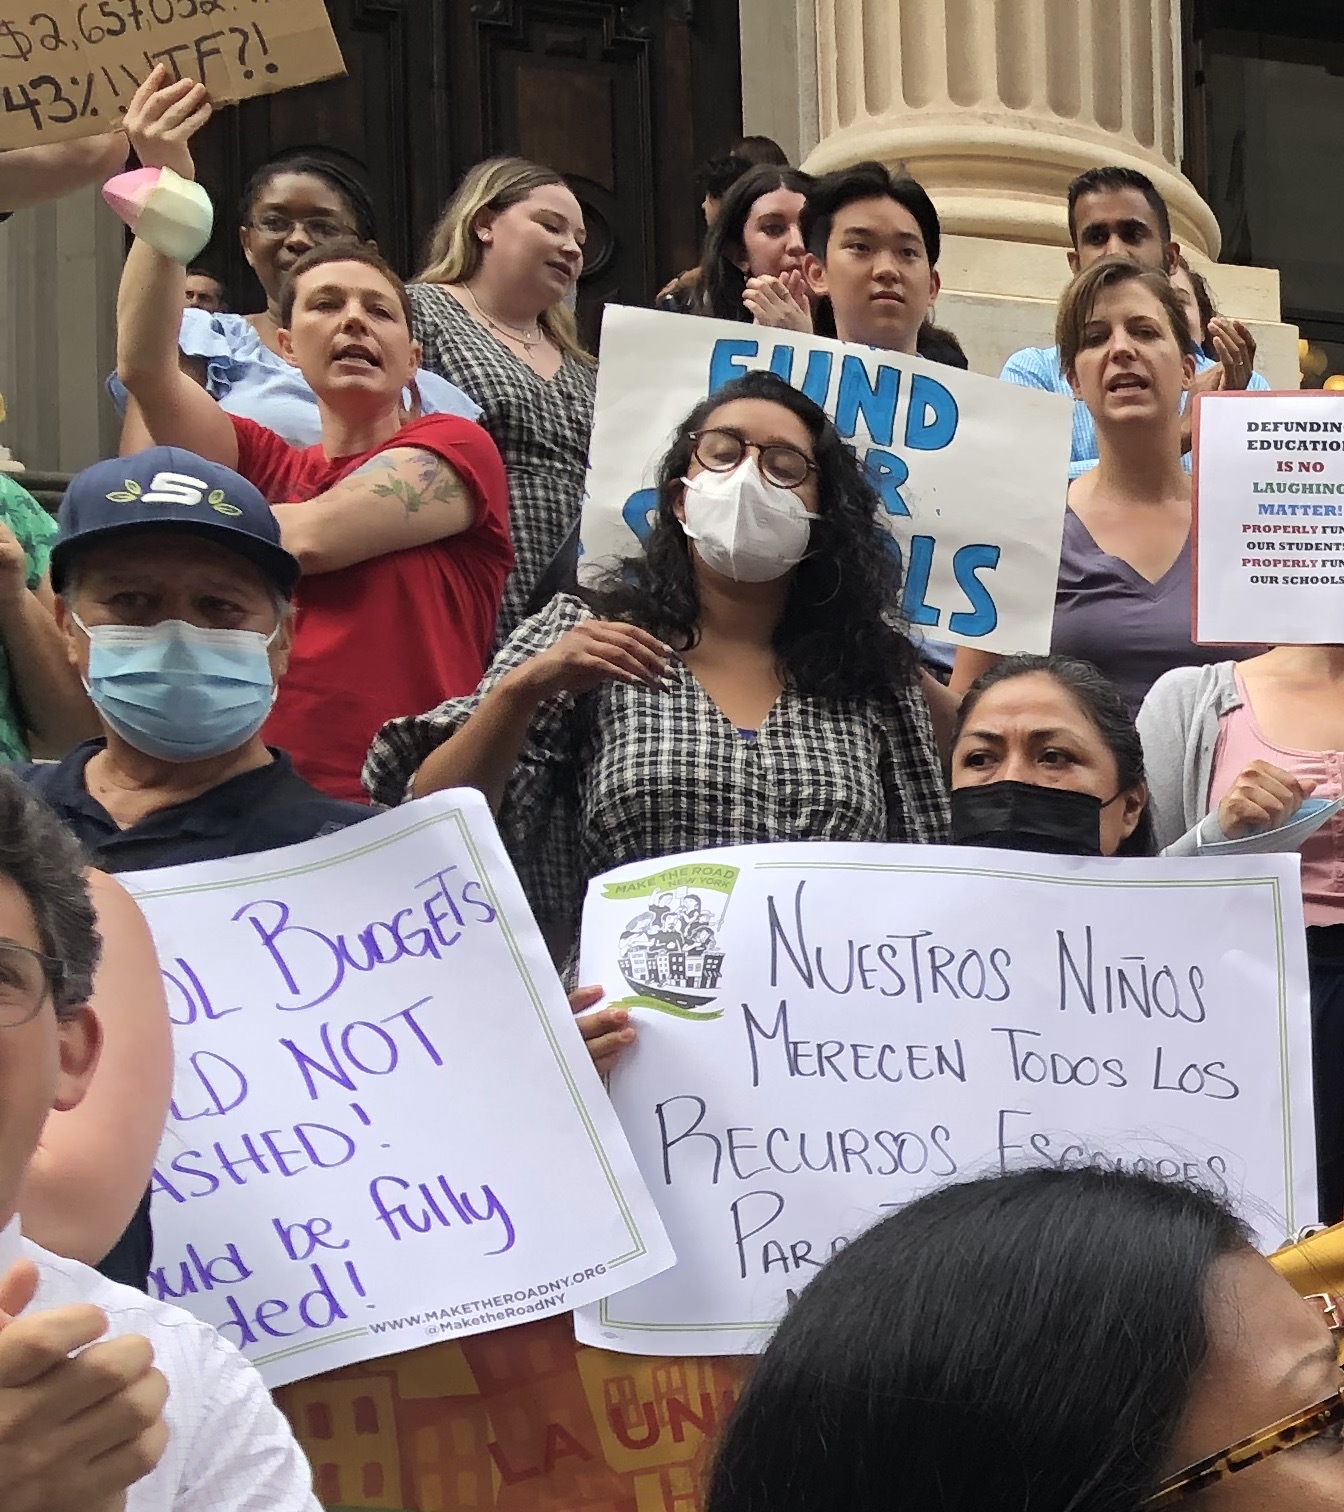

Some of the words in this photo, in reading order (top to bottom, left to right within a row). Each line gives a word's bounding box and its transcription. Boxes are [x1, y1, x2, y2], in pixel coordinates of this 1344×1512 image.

[708, 339, 959, 451] FUND
[1277, 461, 1295, 473] IS
[1298, 461, 1325, 473] NO
[1242, 524, 1318, 535] PROPERLY
[1258, 504, 1343, 517] MATTER!
[1242, 558, 1318, 569] PROPERLY
[1246, 541, 1276, 552] OUR
[1250, 575, 1280, 586] OUR
[615, 878, 656, 894] MAKE
[659, 868, 688, 882] THE
[691, 866, 735, 879] ROAD
[668, 876, 699, 888] NEW
[699, 876, 730, 888] YORK
[767, 880, 1011, 1004] NUESTROS
[1056, 924, 1205, 1024] NIÑOS
[279, 996, 444, 1101] NOT
[741, 1001, 965, 1088] MERECEN
[991, 1027, 1127, 1088] TODOS
[1153, 1045, 1240, 1099] LOS
[151, 1102, 391, 1203] ASHED!
[654, 1094, 957, 1187] RECURSOS
[272, 1217, 350, 1261] be
[369, 1172, 516, 1256] fully
[217, 1261, 376, 1350] ded!
[367, 1262, 607, 1336] WWW.MAKETHEROADNY.ORG
[424, 1293, 567, 1337] @MaketheRoadNY
